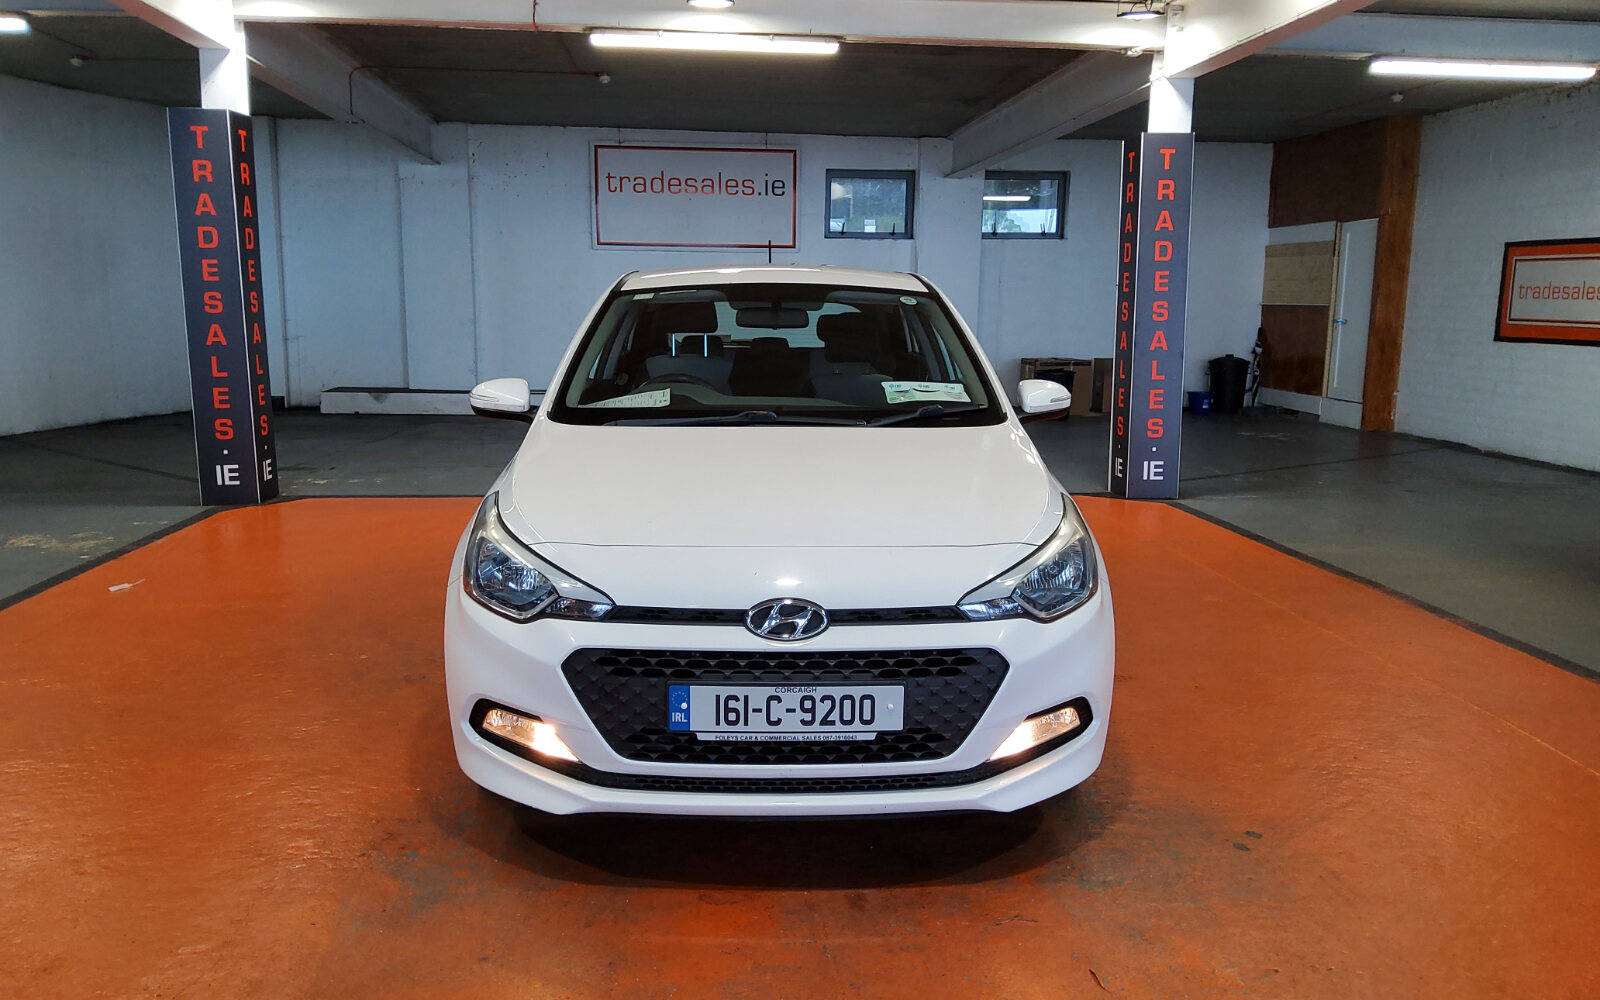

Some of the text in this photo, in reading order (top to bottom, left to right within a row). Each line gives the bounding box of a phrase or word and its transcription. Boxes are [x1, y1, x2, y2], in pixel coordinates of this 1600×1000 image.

[605, 170, 786, 197] tradesales.ie
[774, 686, 817, 694] CORCAIGH
[671, 712, 688, 723] IRL
[715, 694, 876, 726] 161-C-9200
